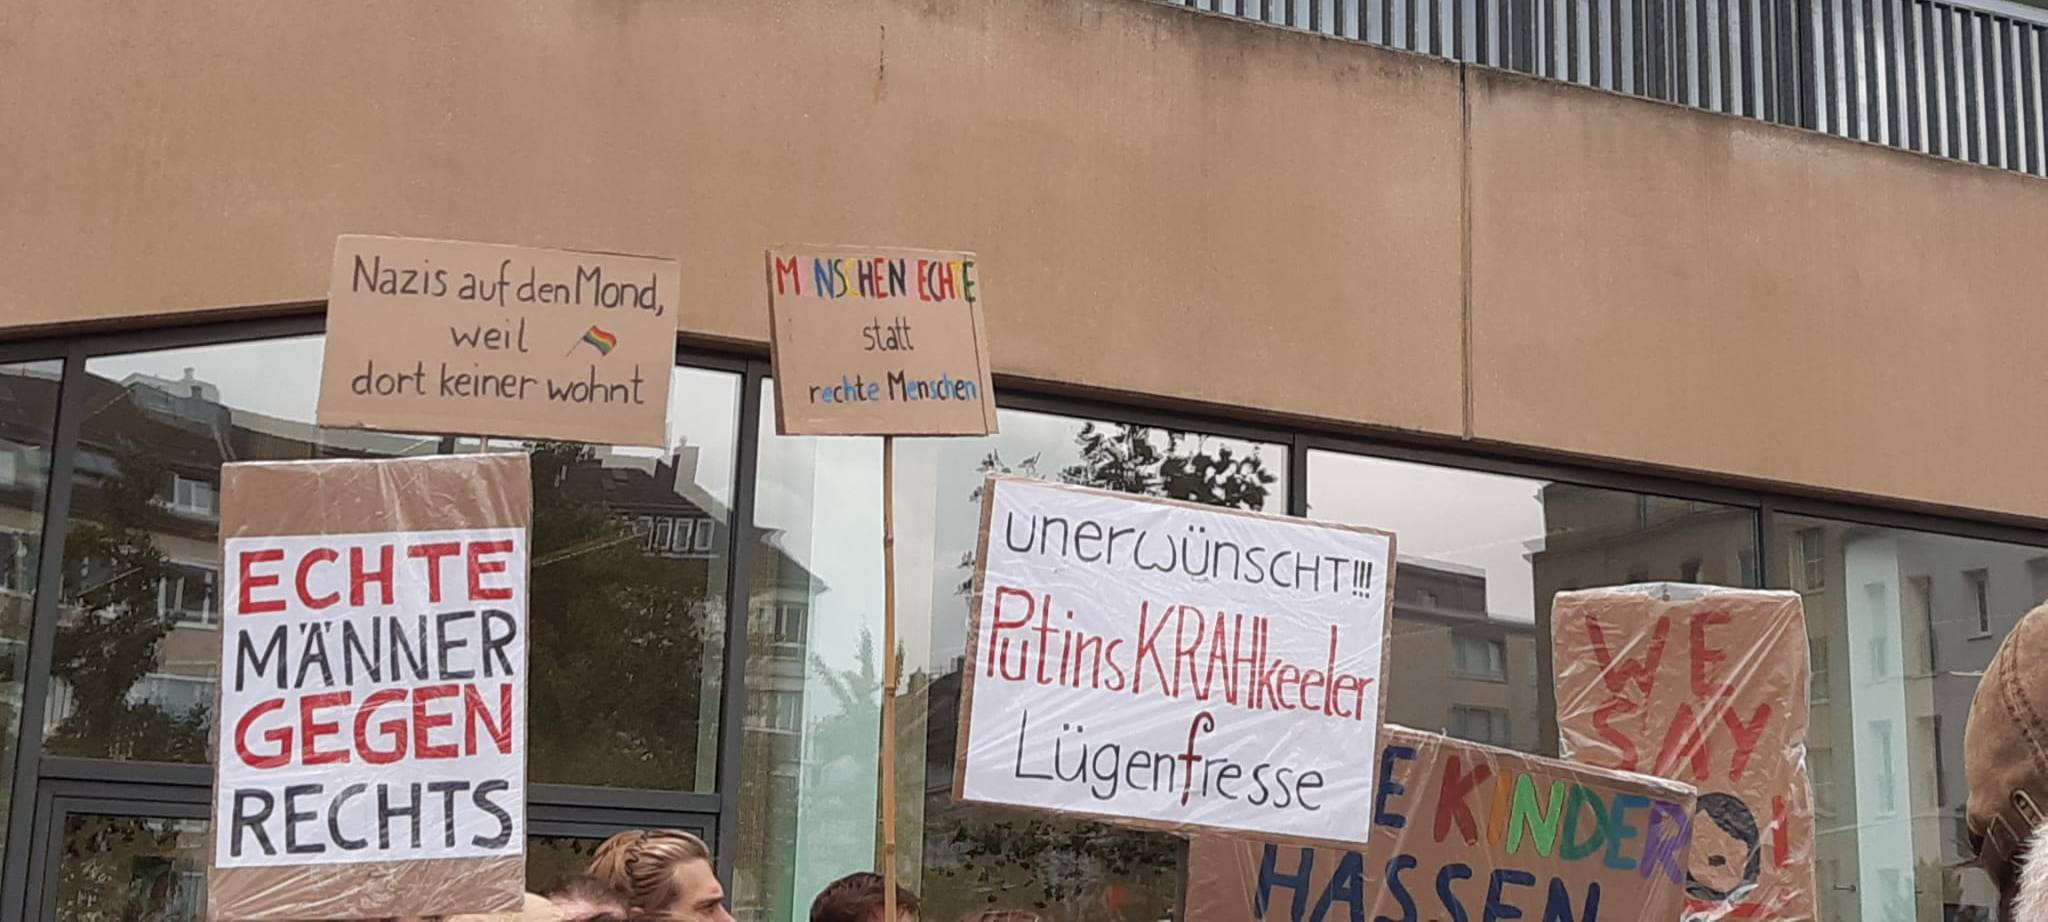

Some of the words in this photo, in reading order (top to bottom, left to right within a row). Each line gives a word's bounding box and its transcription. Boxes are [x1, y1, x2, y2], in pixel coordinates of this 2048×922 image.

[352, 255, 448, 297] Nazis
[457, 259, 512, 307] auf
[516, 266, 570, 304] den
[575, 265, 664, 317] Mond,
[451, 317, 529, 352] weil
[863, 316, 914, 350] statt
[351, 360, 427, 396] dort
[440, 362, 538, 399] keiner
[547, 364, 645, 404] wohnt
[809, 373, 880, 404] rechte
[887, 369, 977, 402] Menschen
[237, 539, 514, 615] ECHTE
[234, 608, 517, 692] MÄNNER
[1585, 611, 1735, 697] WE
[233, 682, 514, 769] GEGEN
[1015, 708, 1326, 812] Lügenfresse
[1580, 697, 1773, 783] SAY
[230, 779, 514, 858] RECHTS
[1432, 754, 1694, 886] KINDER
[1254, 842, 1601, 922] HASSEN
